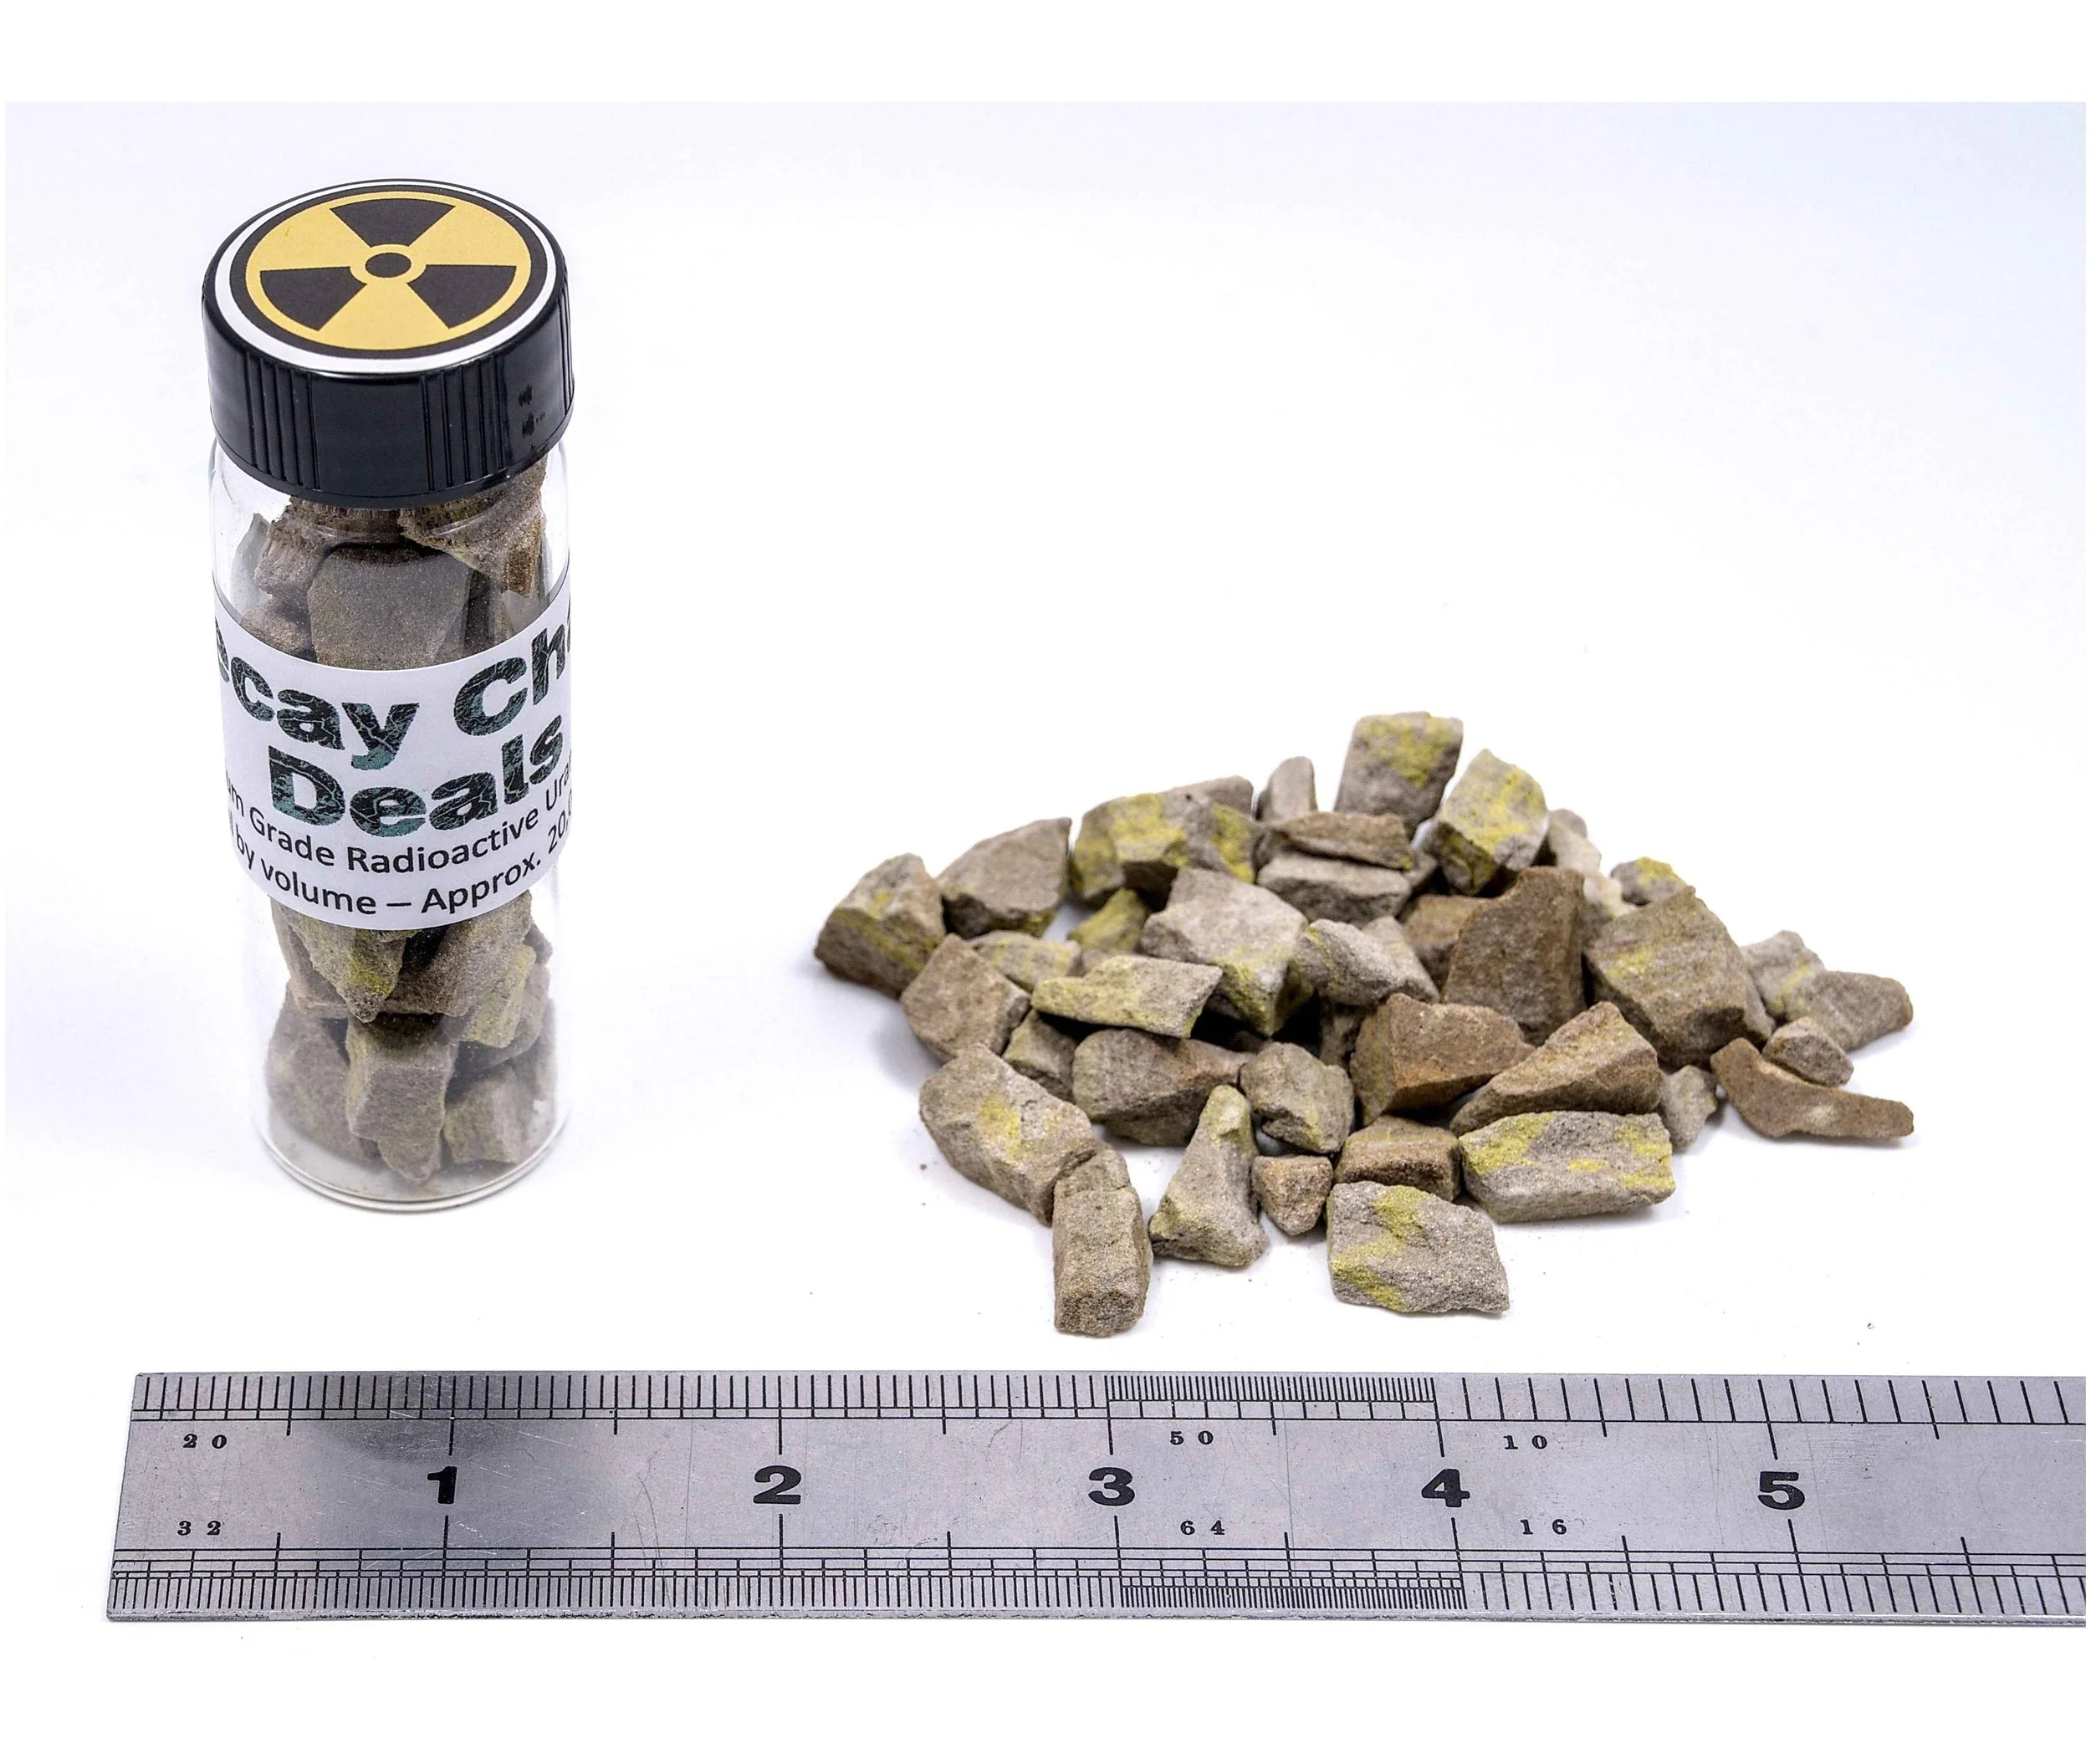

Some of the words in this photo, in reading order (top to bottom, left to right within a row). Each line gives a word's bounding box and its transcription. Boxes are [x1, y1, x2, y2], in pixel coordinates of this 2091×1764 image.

[453, 591, 570, 736] Ch
[268, 714, 564, 837] Deals
[249, 806, 335, 867] Grade
[347, 808, 539, 874] Radioactive
[236, 822, 255, 870] by
[261, 857, 376, 914] volume
[421, 851, 541, 913] Approx.
[427, 1465, 458, 1505] 1
[753, 1465, 802, 1505] 2
[1087, 1466, 1136, 1507] 3
[1420, 1468, 1471, 1508] 4
[1757, 1470, 1806, 1511] 5
